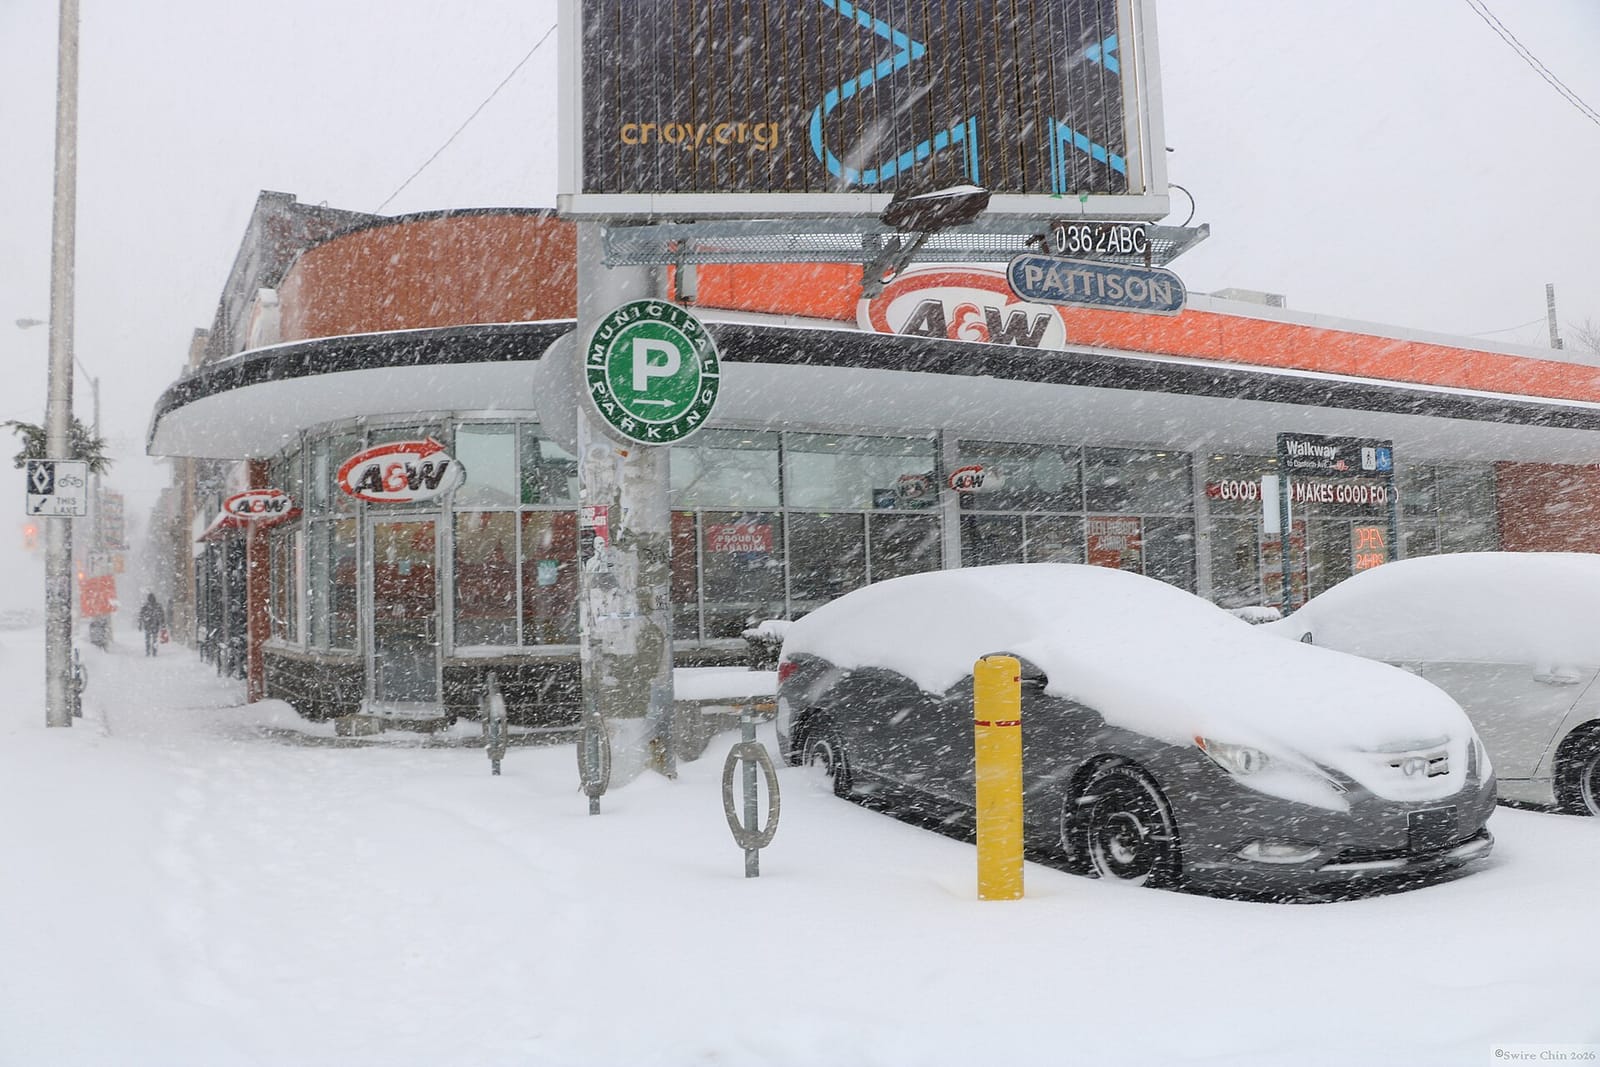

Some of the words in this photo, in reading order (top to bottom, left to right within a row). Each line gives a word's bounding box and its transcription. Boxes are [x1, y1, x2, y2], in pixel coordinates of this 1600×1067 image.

[620, 122, 779, 151] cnoy.org
[1056, 225, 1146, 254] 0362ABC
[1024, 264, 1174, 305] PATTISON
[591, 305, 714, 371] MUNICIPAL
[898, 299, 1053, 348] A&W
[632, 337, 681, 392] P
[591, 380, 713, 439] PARKING
[1286, 440, 1336, 460] Walkway
[352, 459, 449, 494] A&W
[956, 475, 985, 488] A&W
[56, 497, 77, 505] THIS
[235, 500, 287, 513] A&W
[1220, 480, 1257, 500] GOOD
[1297, 483, 1333, 504] MAKES
[1336, 485, 1367, 504] GOOD
[715, 544, 766, 552] CANADIAN
[717, 535, 762, 544] PROUDLY
